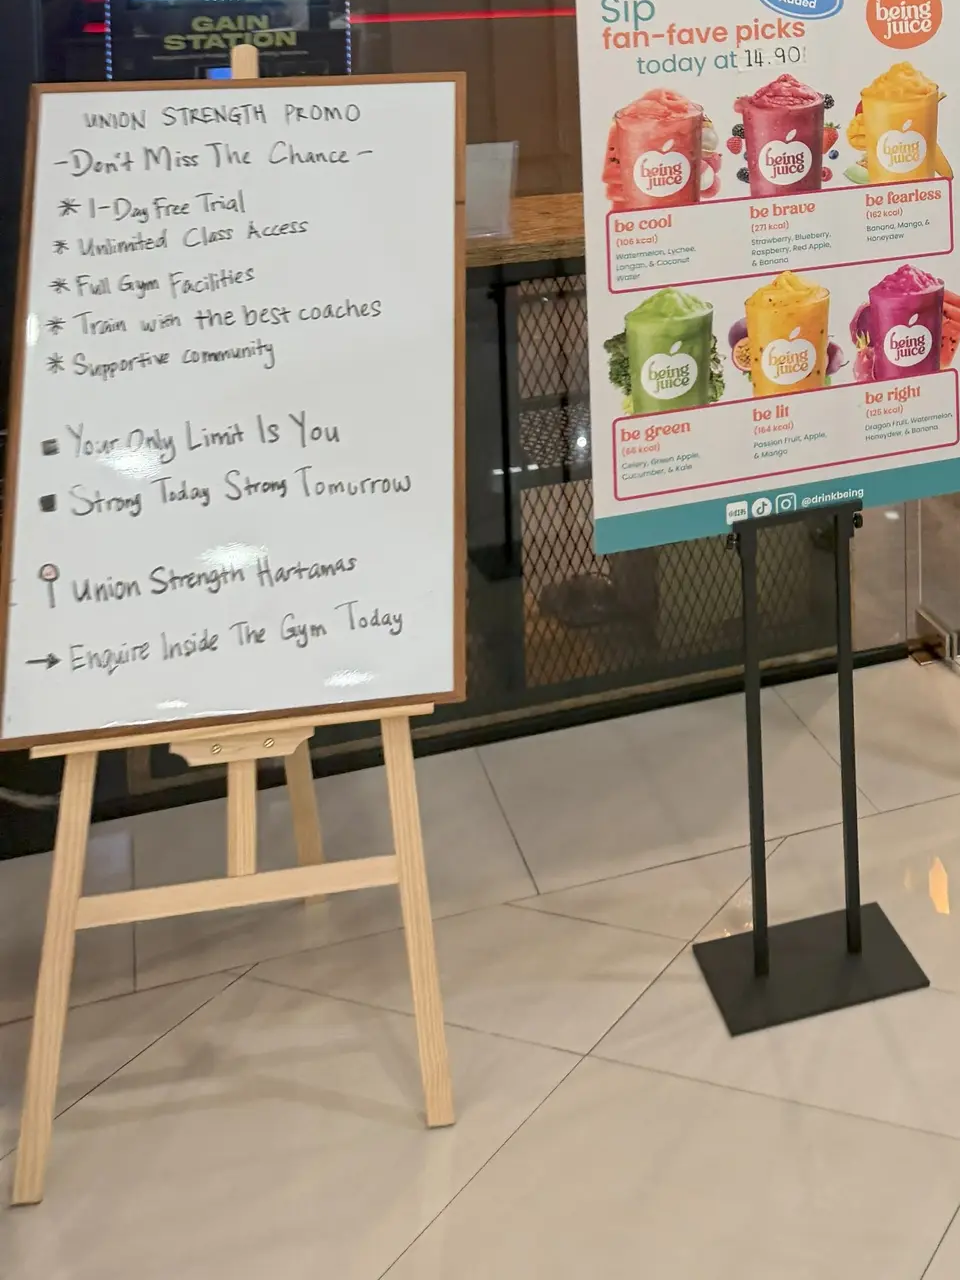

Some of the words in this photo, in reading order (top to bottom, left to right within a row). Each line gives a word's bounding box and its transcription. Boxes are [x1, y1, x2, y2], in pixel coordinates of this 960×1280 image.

[191, 15, 270, 32] GAIN
[883, 15, 933, 39] juice
[163, 30, 298, 51] STATION
[602, 22, 729, 50] fan-fave
[736, 18, 806, 48] picks
[637, 53, 707, 76] today
[714, 49, 738, 70] at
[84, 111, 146, 130] UNION
[162, 104, 267, 127] STRENGTH
[285, 103, 361, 122] PROMO
[144, 145, 199, 173] Miss
[206, 140, 251, 168] The
[765, 148, 804, 168] being
[882, 139, 920, 160] being
[888, 150, 919, 166] juice
[641, 155, 683, 178] being
[771, 160, 805, 179] juice
[647, 171, 683, 190] juice
[154, 196, 191, 217] Free
[195, 190, 246, 214] Trial
[865, 193, 884, 207] be
[887, 189, 942, 204] fearless
[750, 205, 769, 219] be
[773, 201, 816, 217] brave
[883, 207, 903, 217] kcal)
[615, 219, 634, 233] be
[639, 214, 672, 230] cool
[768, 220, 789, 230] kcal)
[79, 229, 168, 258] Unlimited
[183, 225, 234, 249] Class
[247, 220, 309, 239] Access
[751, 235, 793, 246] Strawberry,
[795, 231, 832, 241] Blueberry,
[751, 246, 792, 256] Raspberry,
[656, 257, 690, 266] Coconut
[759, 257, 789, 266] Banana
[76, 275, 111, 297] Full
[117, 275, 160, 300] Gym
[169, 267, 256, 299] Facilities
[616, 273, 640, 282] Water
[72, 312, 127, 337] Train
[141, 312, 181, 333] with
[194, 306, 237, 331] the
[242, 304, 292, 325] best
[299, 298, 382, 321] coaches
[889, 331, 926, 351] being
[73, 349, 170, 381] Supportive
[181, 339, 276, 370] community
[767, 344, 809, 366] being
[896, 344, 926, 360] juice
[648, 360, 690, 382] being
[776, 361, 809, 377] juice
[656, 375, 690, 392] juice
[865, 391, 883, 404] be
[888, 385, 921, 402] right
[752, 408, 771, 422] be
[775, 404, 790, 418] lit
[883, 404, 903, 414] kcal)
[620, 428, 640, 442] be
[645, 421, 691, 442] green
[773, 420, 794, 431] kcal)
[865, 421, 891, 431] Dragon
[911, 424, 939, 434] Banana
[126, 428, 176, 463] Only
[186, 420, 245, 451] Limit
[257, 414, 281, 444] Is
[289, 410, 341, 449] You
[753, 438, 783, 448] Passion
[761, 449, 788, 458] Mango
[675, 463, 693, 472] Kale
[69, 484, 143, 517] Strong
[151, 475, 211, 507] Today
[225, 469, 289, 501] Strong
[72, 576, 142, 604] Union
[151, 563, 246, 597] Strength
[256, 555, 357, 588] Hartamas
[70, 638, 151, 674] Enquire
[162, 629, 220, 661] Inside
[229, 621, 267, 648] The
[280, 613, 328, 649] Gym
[334, 600, 404, 637] Today
